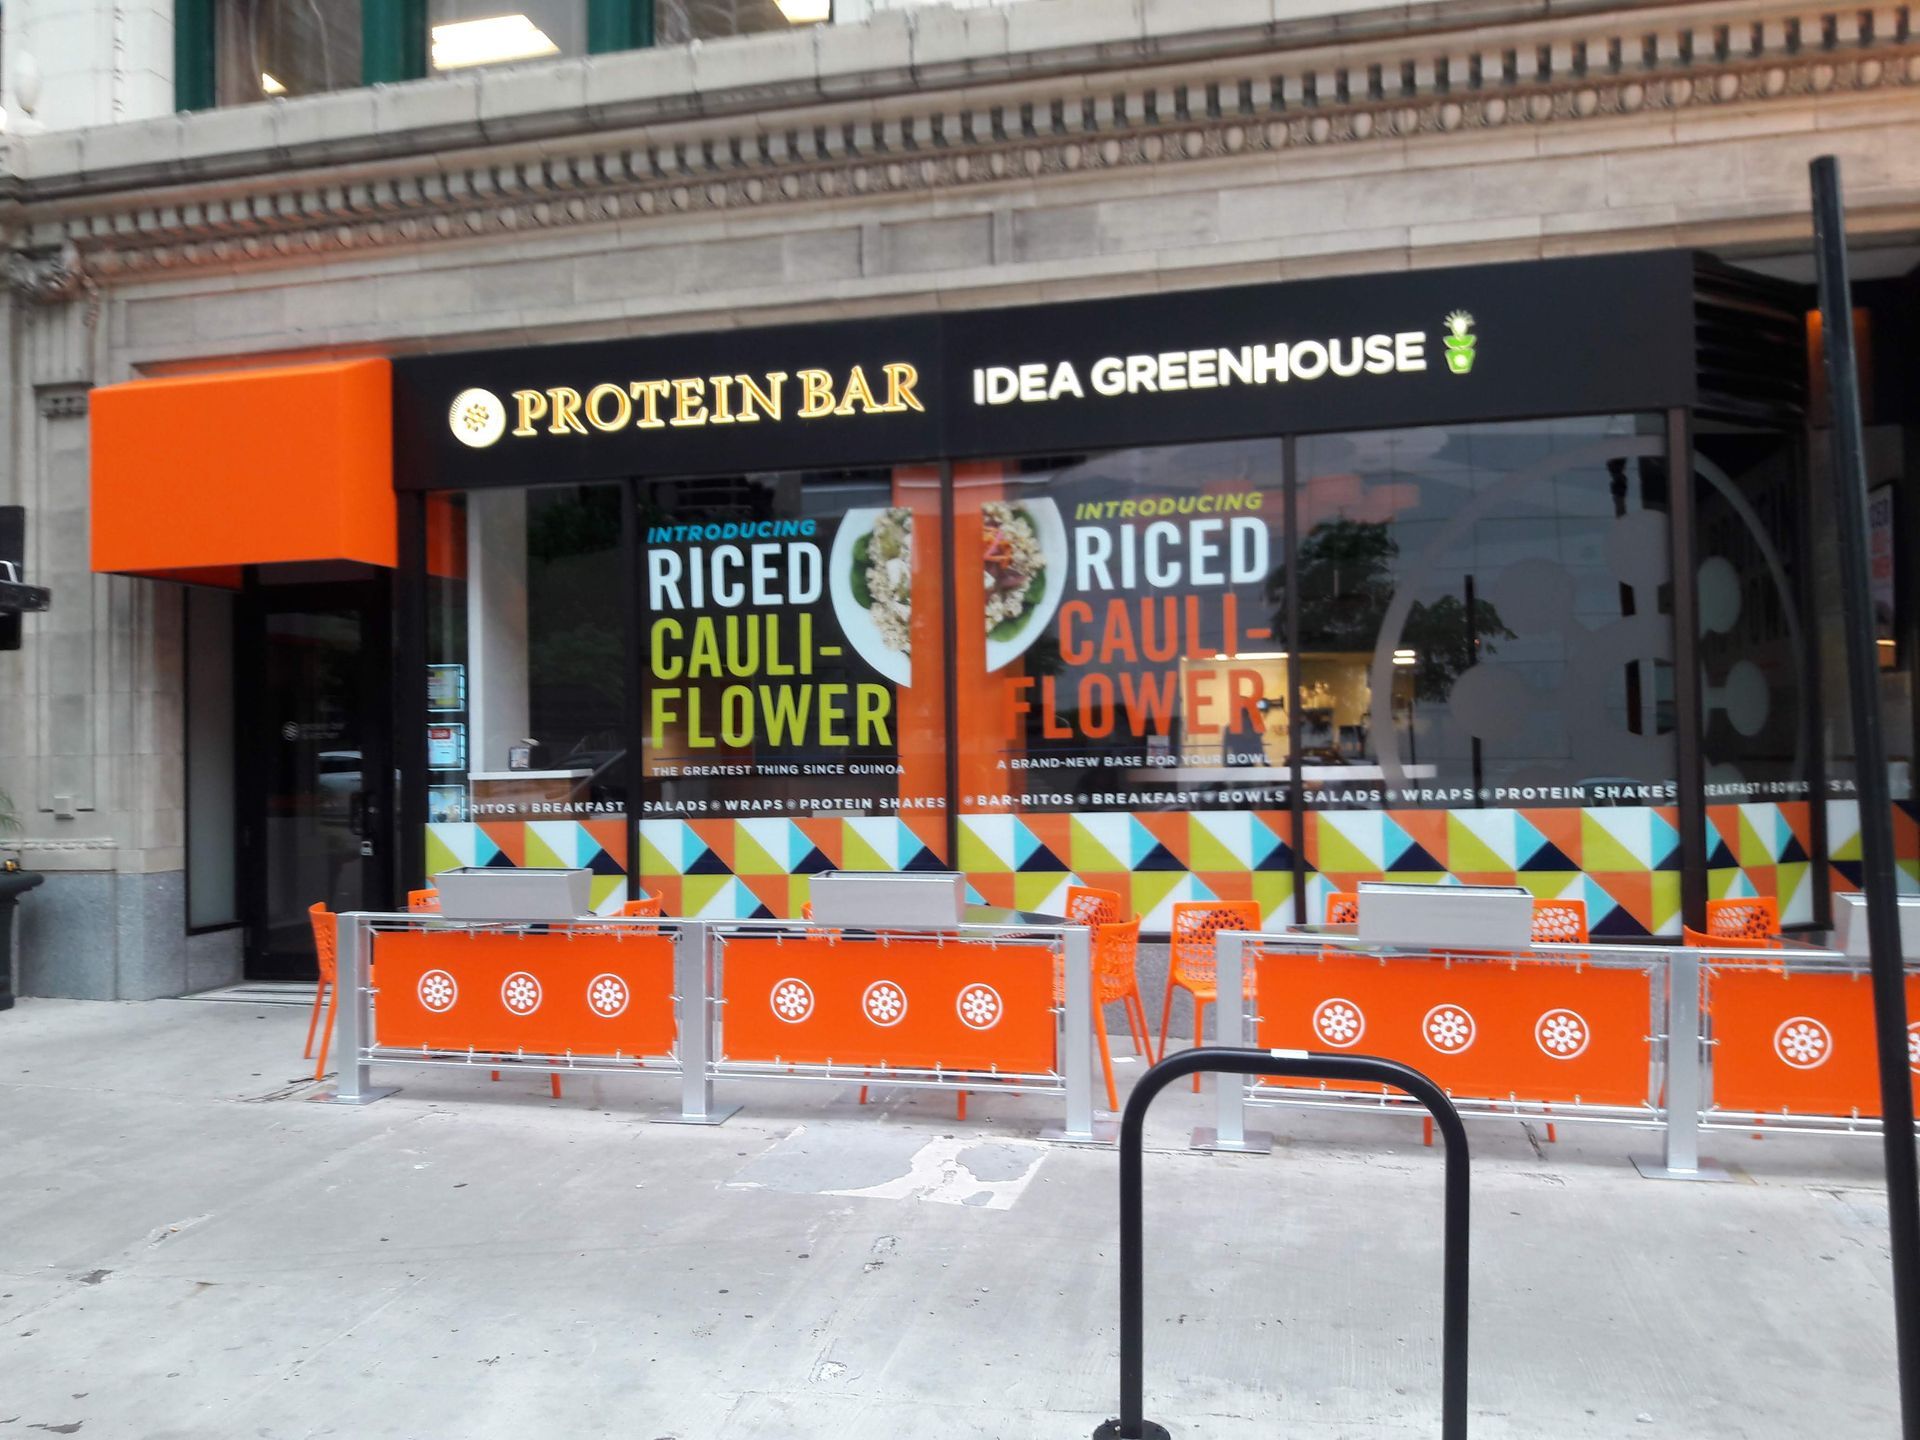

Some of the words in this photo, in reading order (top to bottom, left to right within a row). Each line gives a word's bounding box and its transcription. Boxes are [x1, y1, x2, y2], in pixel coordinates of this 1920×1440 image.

[973, 361, 1084, 405] IDEA
[1091, 332, 1426, 396] GREENHOUSE
[511, 372, 787, 436] PROTEIN
[796, 363, 925, 418] BAR
[1075, 492, 1264, 520] INTRODUCING
[646, 519, 817, 543] INTRODUCING
[1074, 516, 1269, 591] RICED
[648, 542, 823, 611] RICED
[651, 613, 842, 680] CAULI-
[1058, 593, 1272, 665] CAULI-
[651, 683, 893, 749] FLOWER
[1002, 669, 1267, 740] FLOWER
[652, 766, 679, 777] THE
[683, 765, 752, 776] GREATEST
[757, 764, 798, 775] THING
[803, 764, 845, 774] SINCE
[849, 764, 905, 774] QUINOA
[997, 759, 1007, 769] A
[1011, 757, 1100, 769] BRAND-NEW
[1104, 756, 1141, 767] BASE
[1147, 755, 1176, 766] FOR
[1182, 754, 1224, 765] YOUR
[1227, 753, 1271, 764] BOWL
[532, 801, 624, 813] BREAKFAST
[643, 801, 707, 812] SALADS
[724, 799, 783, 810] WRAPS
[800, 798, 872, 809] PROTEIN
[879, 797, 946, 808] SHAKES
[977, 794, 1073, 806] BAR-RITOS
[1093, 791, 1198, 804] BREAKFAST
[1219, 790, 1286, 803] BOWLS
[1303, 789, 1381, 802] SALADS
[1402, 788, 1474, 800] WRAPS
[1495, 787, 1585, 800] PROTEIN
[1594, 785, 1678, 799] SHAKES
